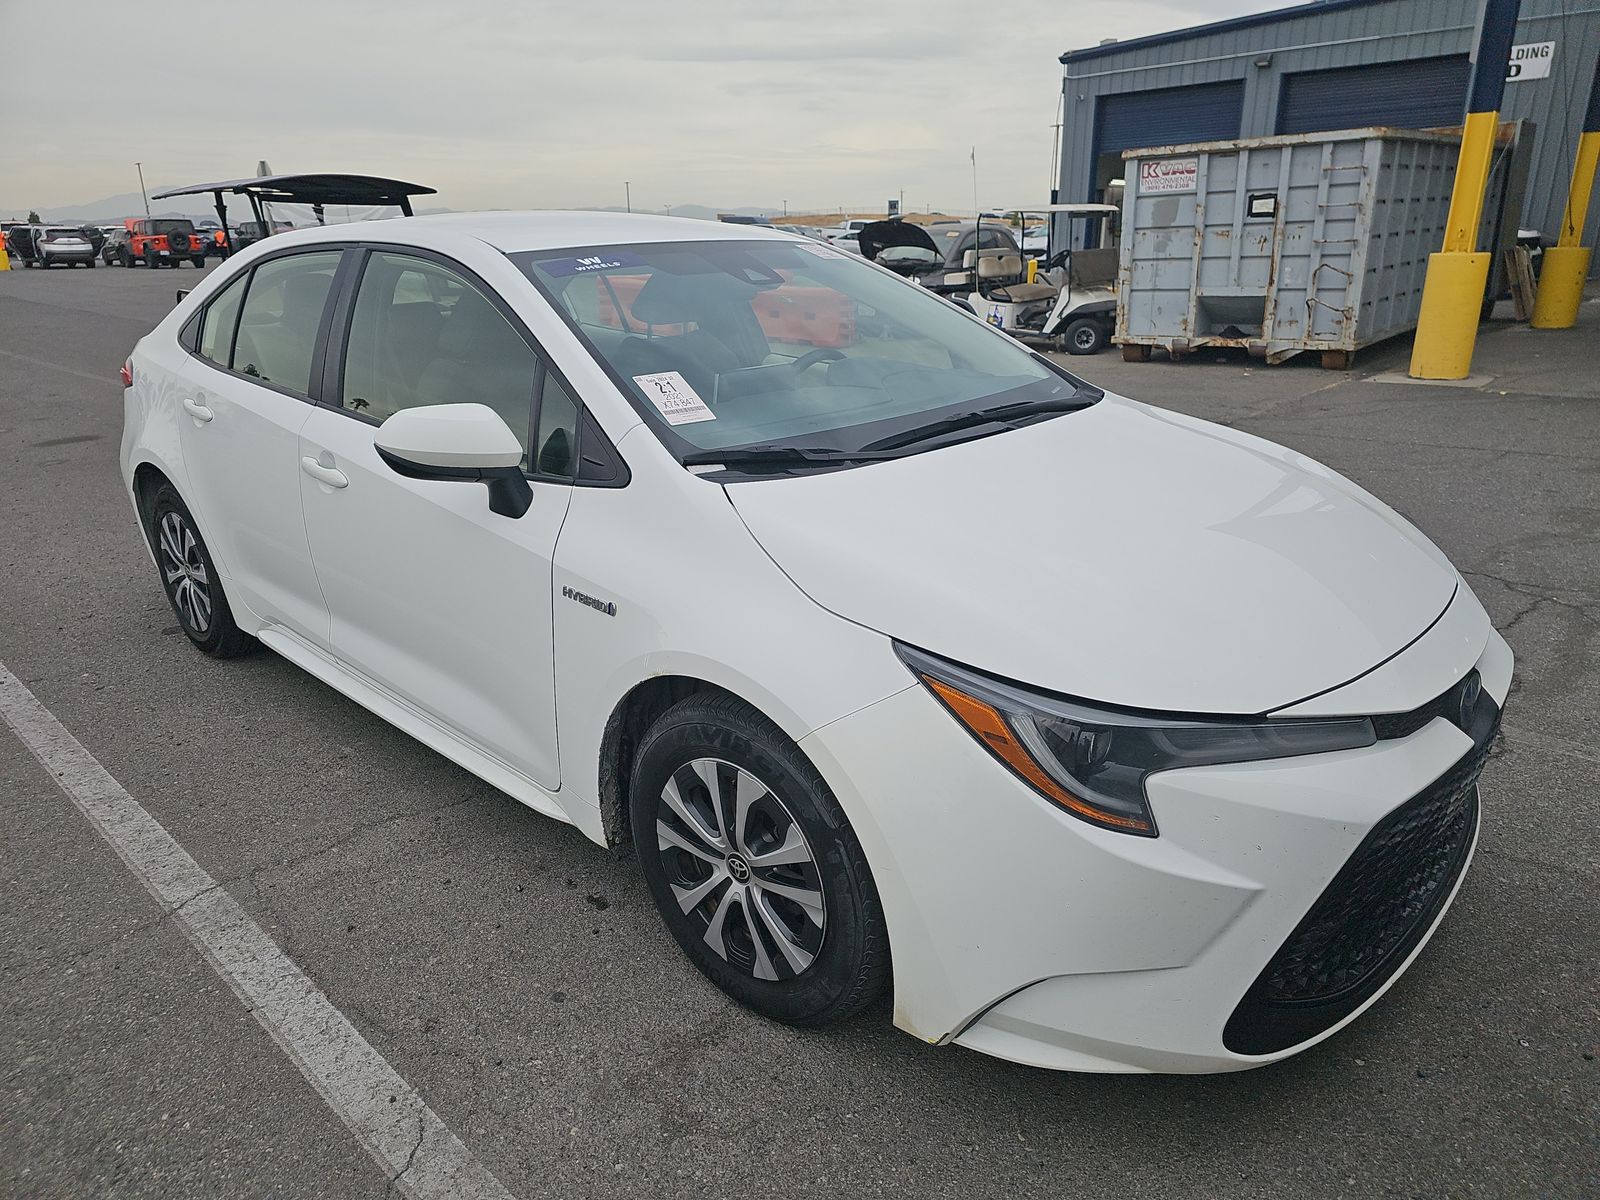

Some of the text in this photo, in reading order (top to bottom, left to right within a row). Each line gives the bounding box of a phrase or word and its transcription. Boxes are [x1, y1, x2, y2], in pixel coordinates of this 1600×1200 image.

[1141, 176, 1196, 186] ENVIRONMENTAL
[575, 261, 621, 271] WHEELS
[655, 381, 677, 394] 2:1
[663, 392, 685, 401] 2021
[562, 586, 608, 614] HYBRID
